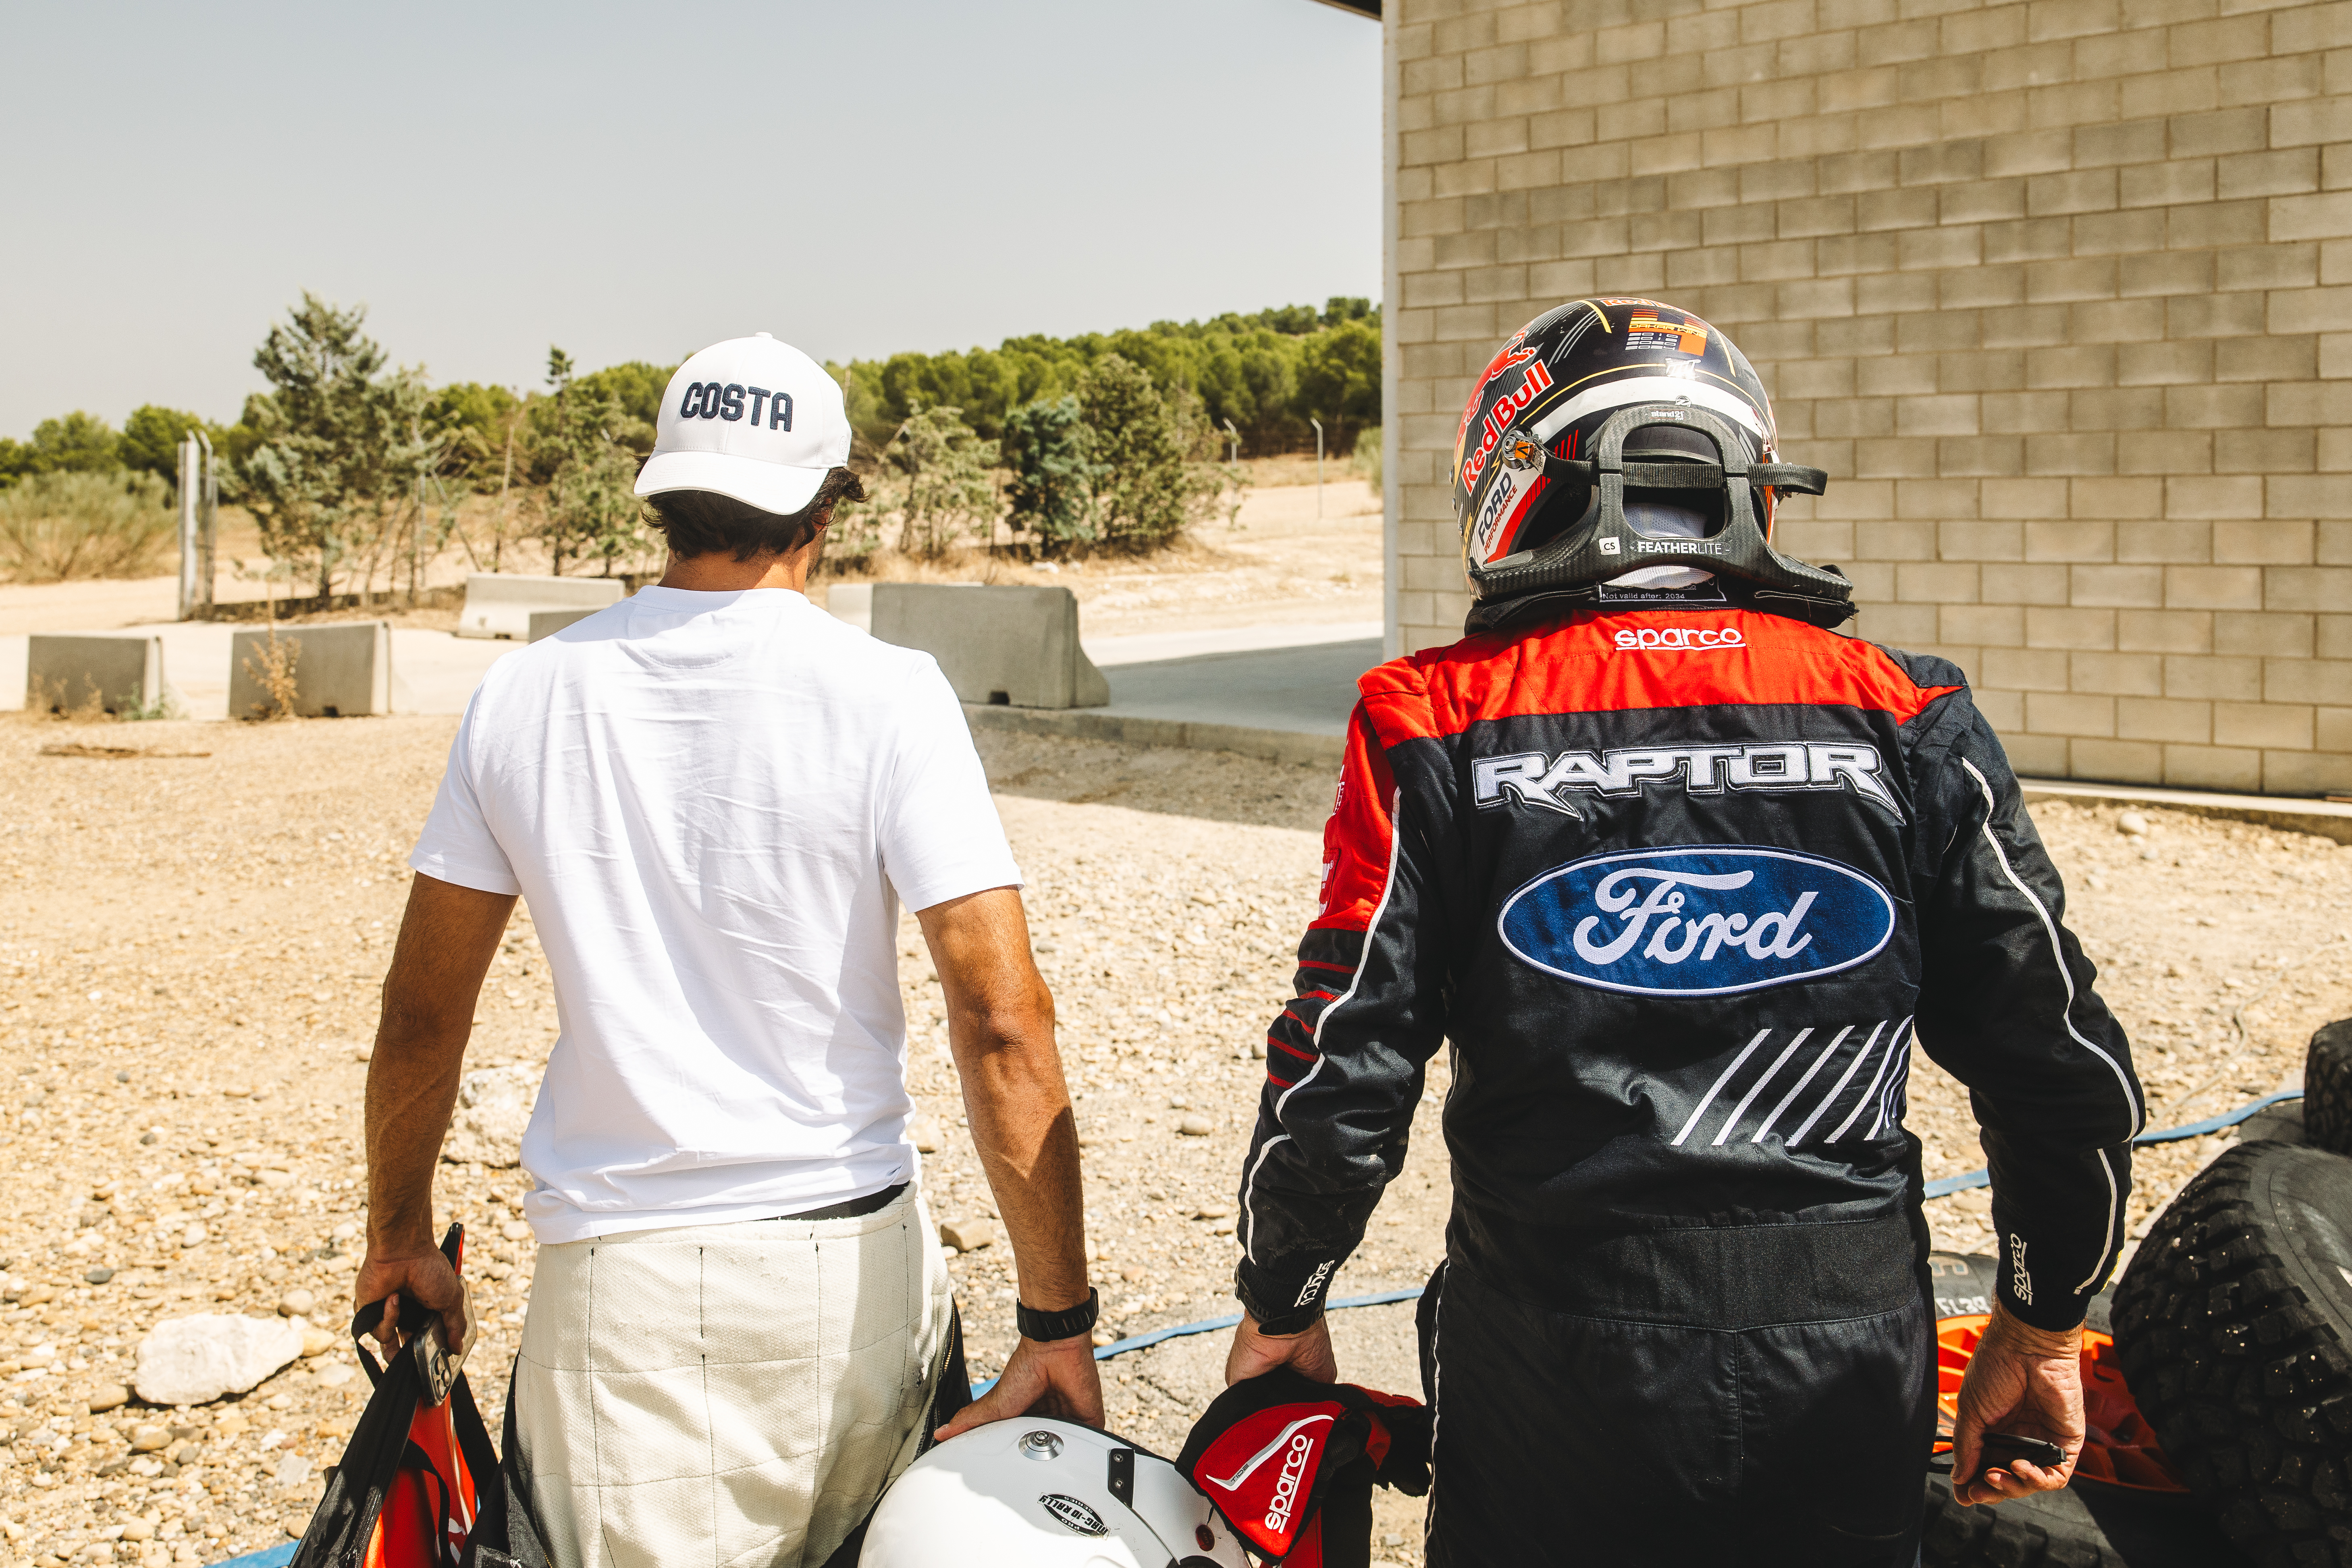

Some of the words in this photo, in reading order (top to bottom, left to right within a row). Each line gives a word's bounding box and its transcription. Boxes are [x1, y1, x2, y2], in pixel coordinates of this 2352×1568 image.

[680, 382, 793, 432] COSTA
[1462, 415, 1500, 495] Red
[1492, 360, 1553, 432] Bull
[1479, 472, 1512, 547] FORD
[1484, 484, 1517, 555] PERFORMANCE
[1637, 541, 1722, 555] FEATHERLITE
[1614, 627, 1746, 650] sparco
[1471, 741, 1907, 826] RAPTOR
[1573, 868, 1819, 966] Ford
[2011, 1233, 2033, 1306] sparco
[1230, 1463, 1249, 1483] TIDE
[1265, 1434, 1314, 1534] sparco
[1039, 1495, 1073, 1514] RALLY
[1061, 1518, 1080, 1531] PRO
[1064, 1496, 1093, 1514] SERIES
[1070, 1509, 1109, 1536] MAG-10
